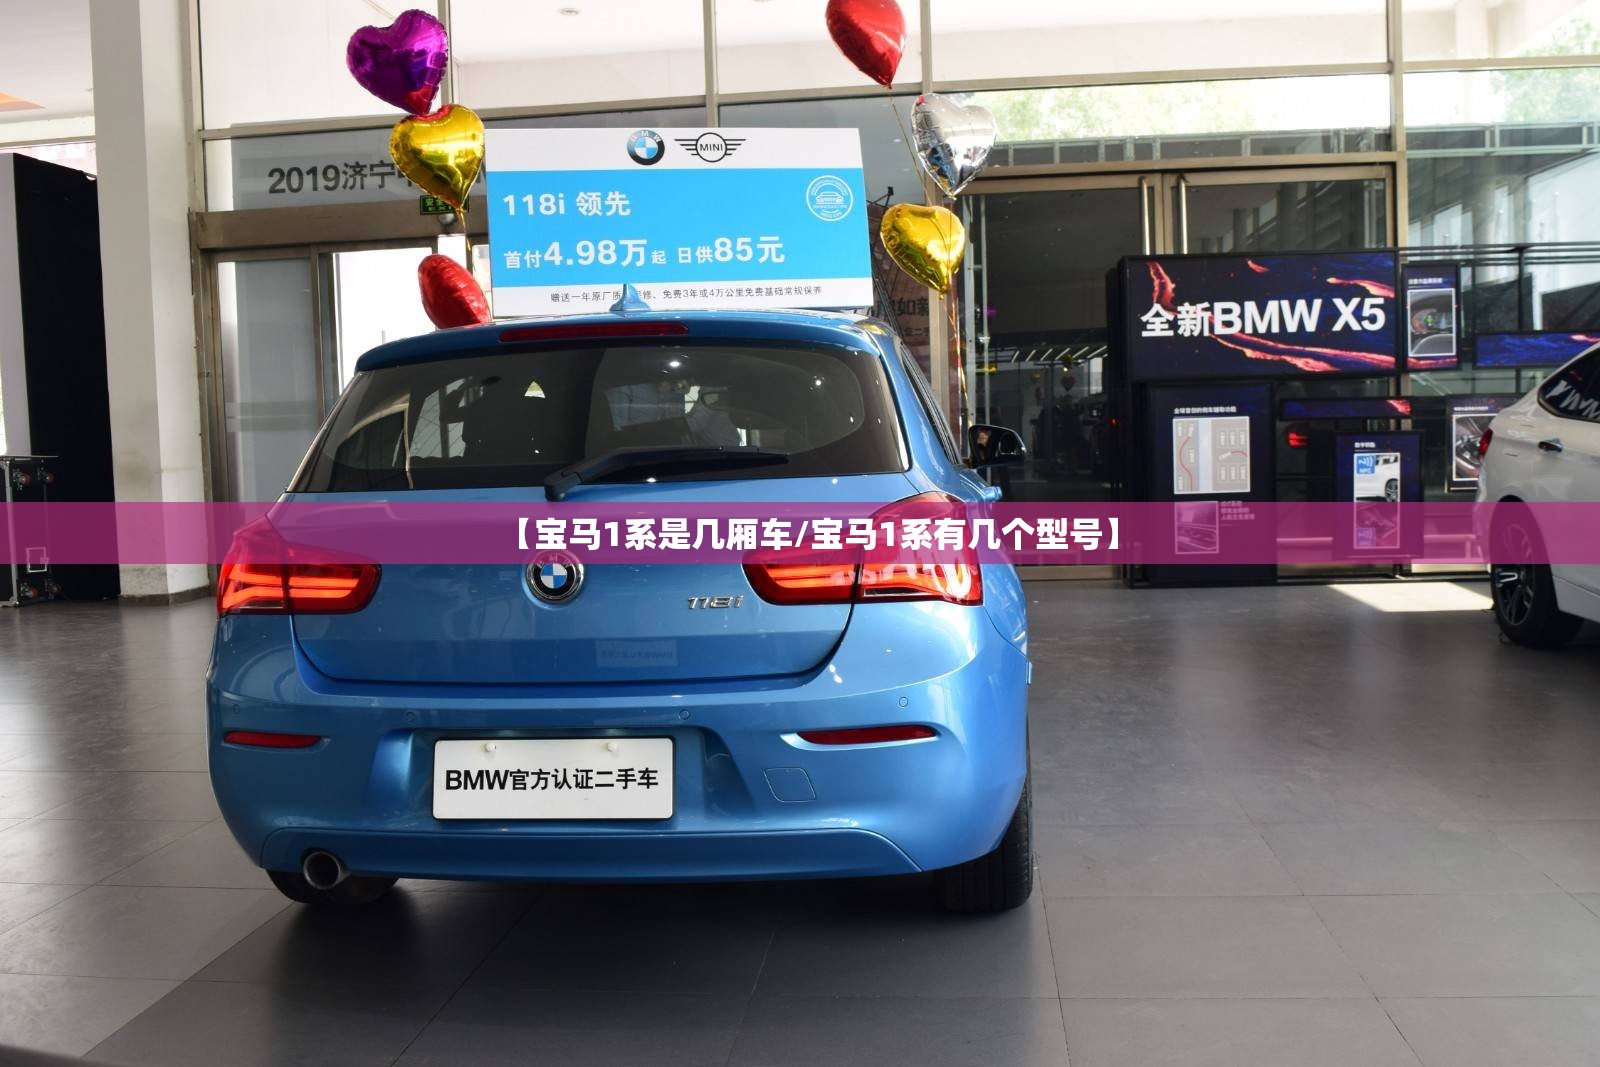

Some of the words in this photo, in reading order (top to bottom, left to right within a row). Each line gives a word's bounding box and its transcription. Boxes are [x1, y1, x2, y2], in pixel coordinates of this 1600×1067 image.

[700, 143, 723, 152] MINI
[503, 193, 566, 216] 118i
[576, 191, 631, 217] 领先
[503, 238, 667, 269] 首付4.98万起
[677, 235, 785, 265] 日供85元
[1140, 298, 1323, 337] 全新BMW
[1332, 297, 1386, 332] X5
[688, 595, 745, 610] 118i
[445, 768, 659, 791] BMW官方认证二手车
